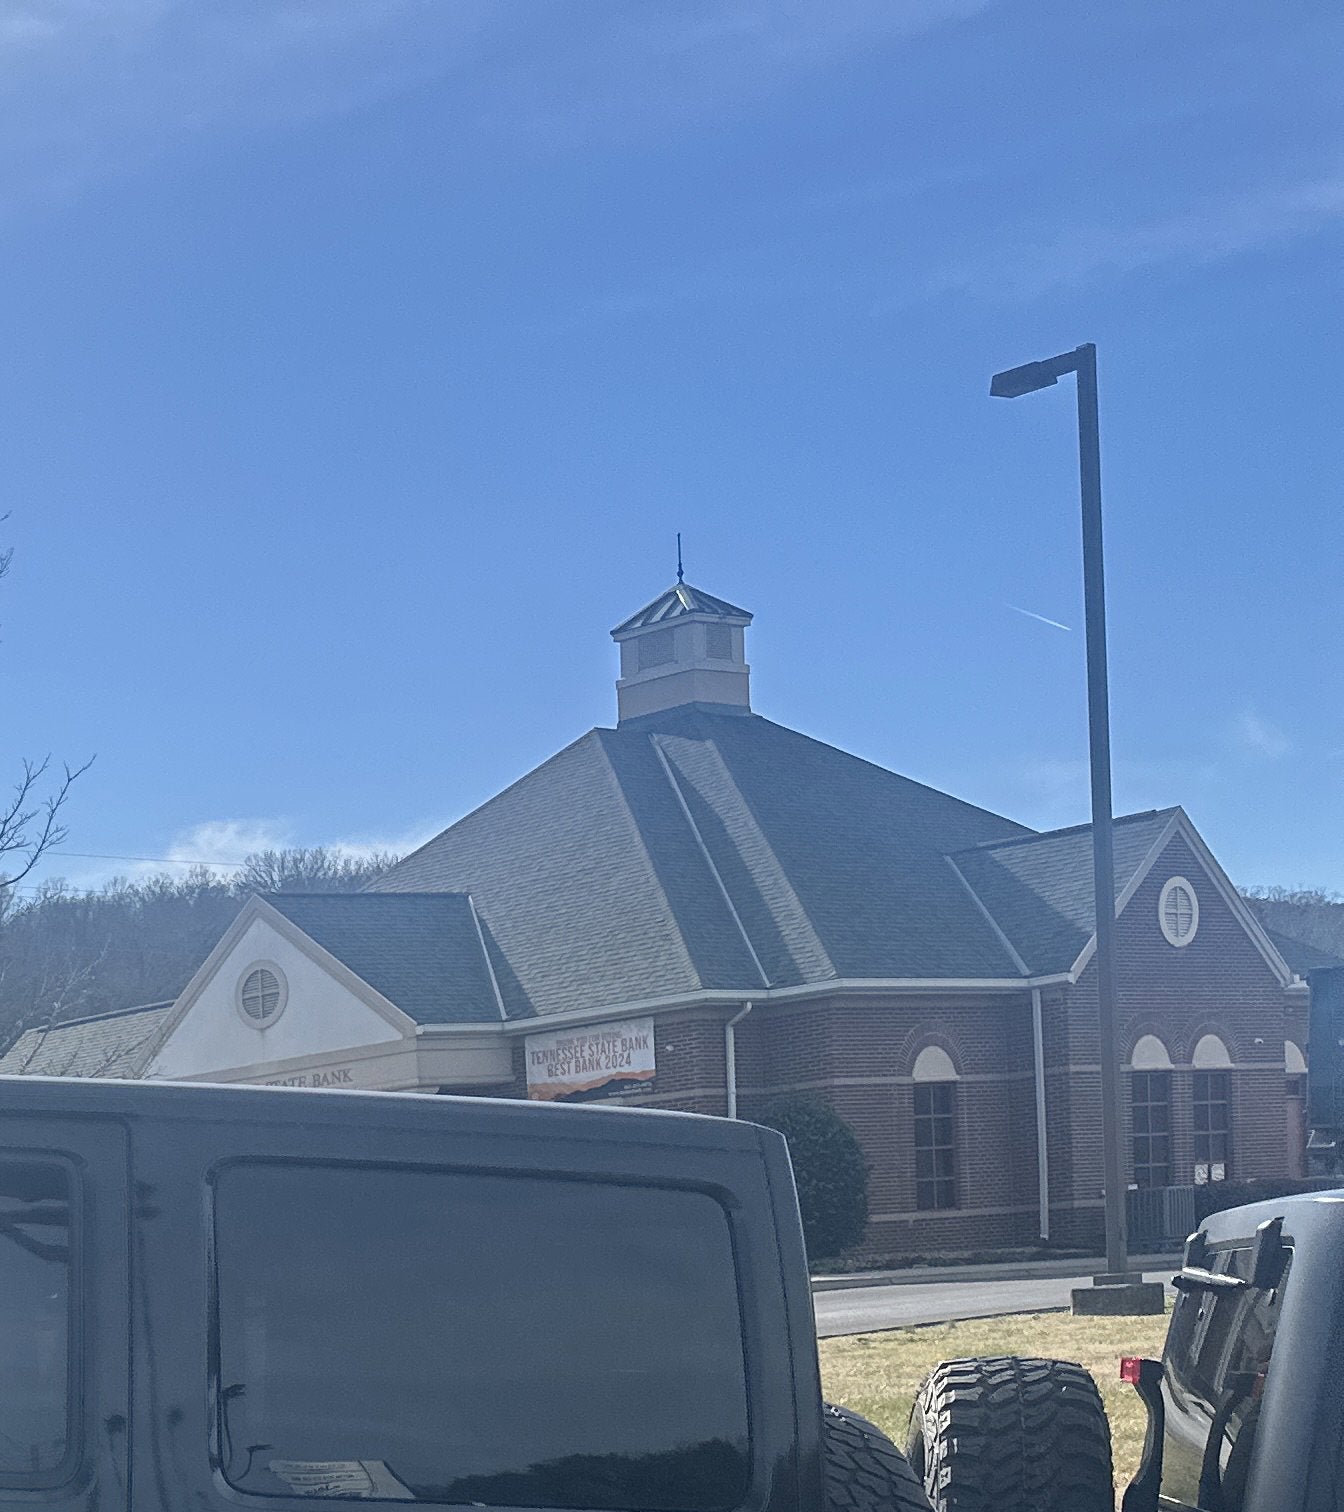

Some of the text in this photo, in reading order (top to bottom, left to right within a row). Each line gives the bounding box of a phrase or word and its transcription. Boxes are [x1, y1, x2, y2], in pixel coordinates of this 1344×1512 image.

[530, 1044, 585, 1066] TENNESSEE
[588, 1039, 618, 1058] STATE
[620, 1034, 649, 1052] BANK
[547, 1053, 631, 1078] BEST BANK 2024
